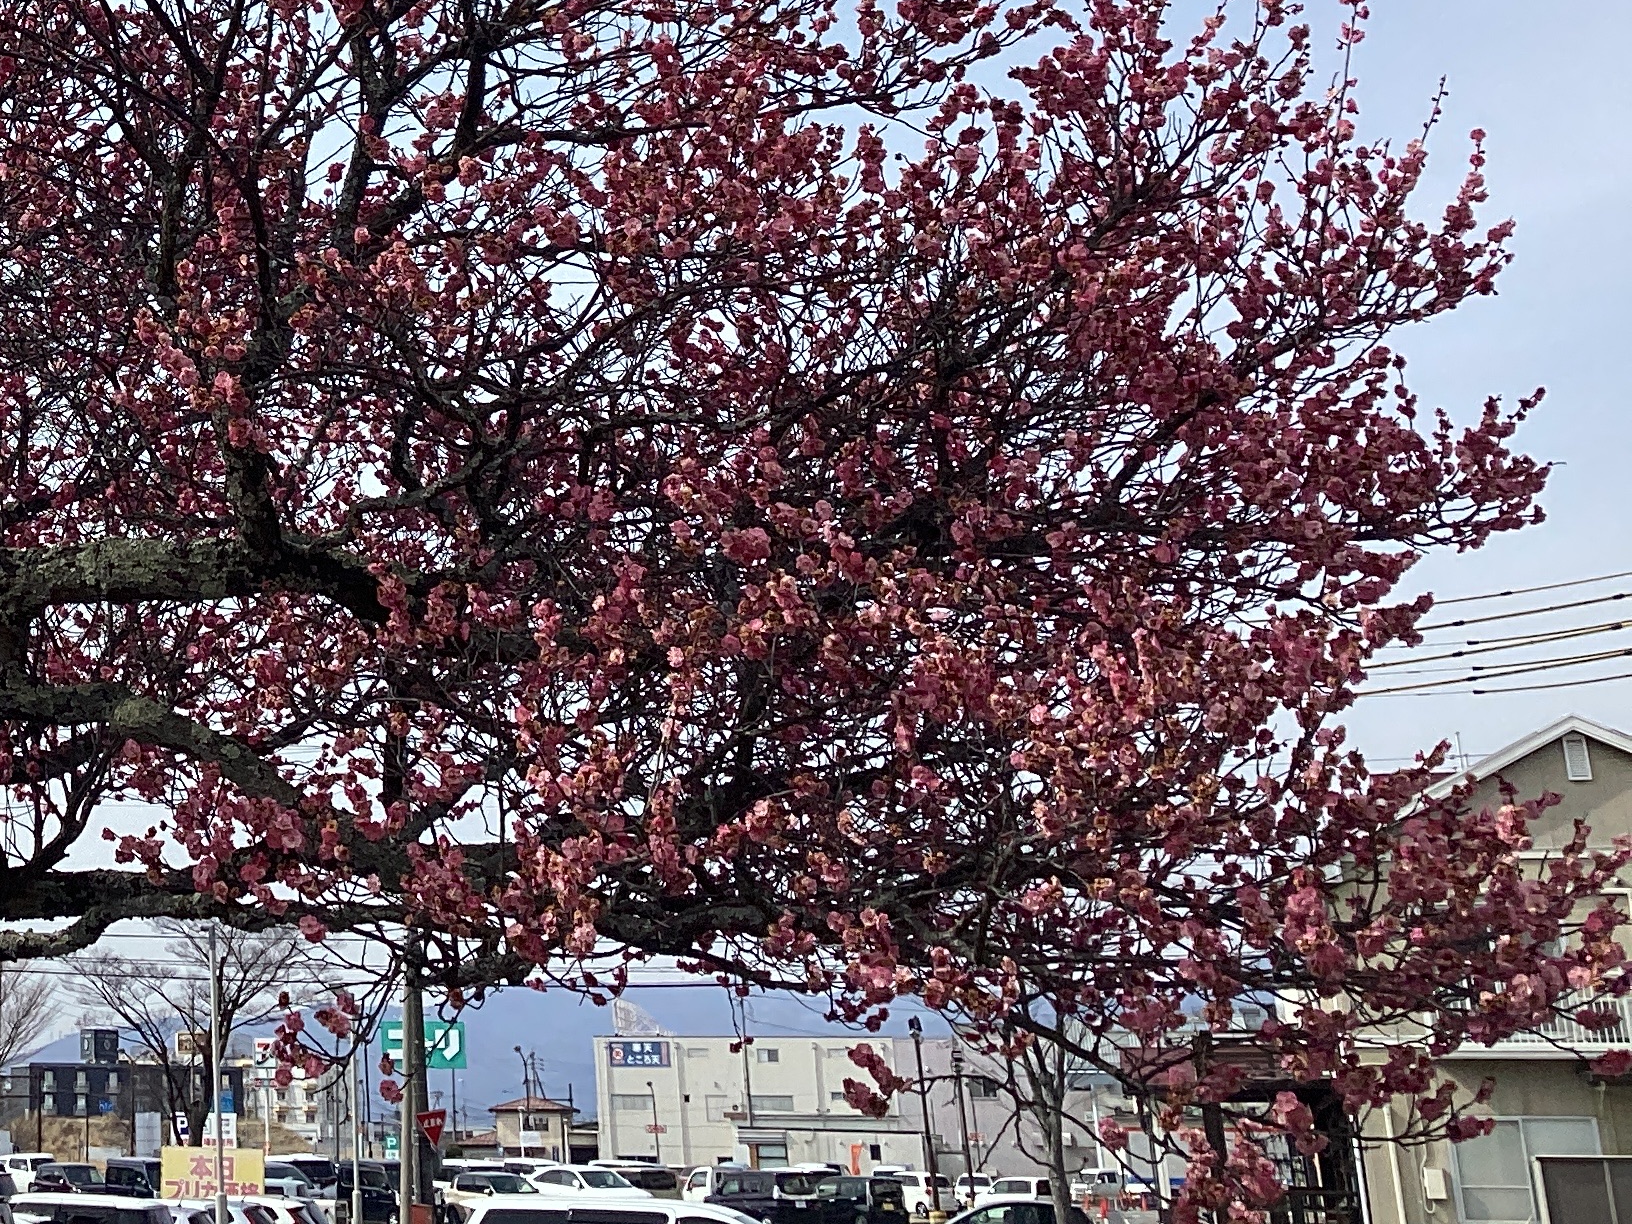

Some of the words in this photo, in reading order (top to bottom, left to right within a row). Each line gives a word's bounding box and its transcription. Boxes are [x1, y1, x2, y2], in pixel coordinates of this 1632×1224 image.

[387, 1029, 460, 1061] ニリ
[386, 1137, 397, 1149] P
[189, 1155, 235, 1181] 本日
